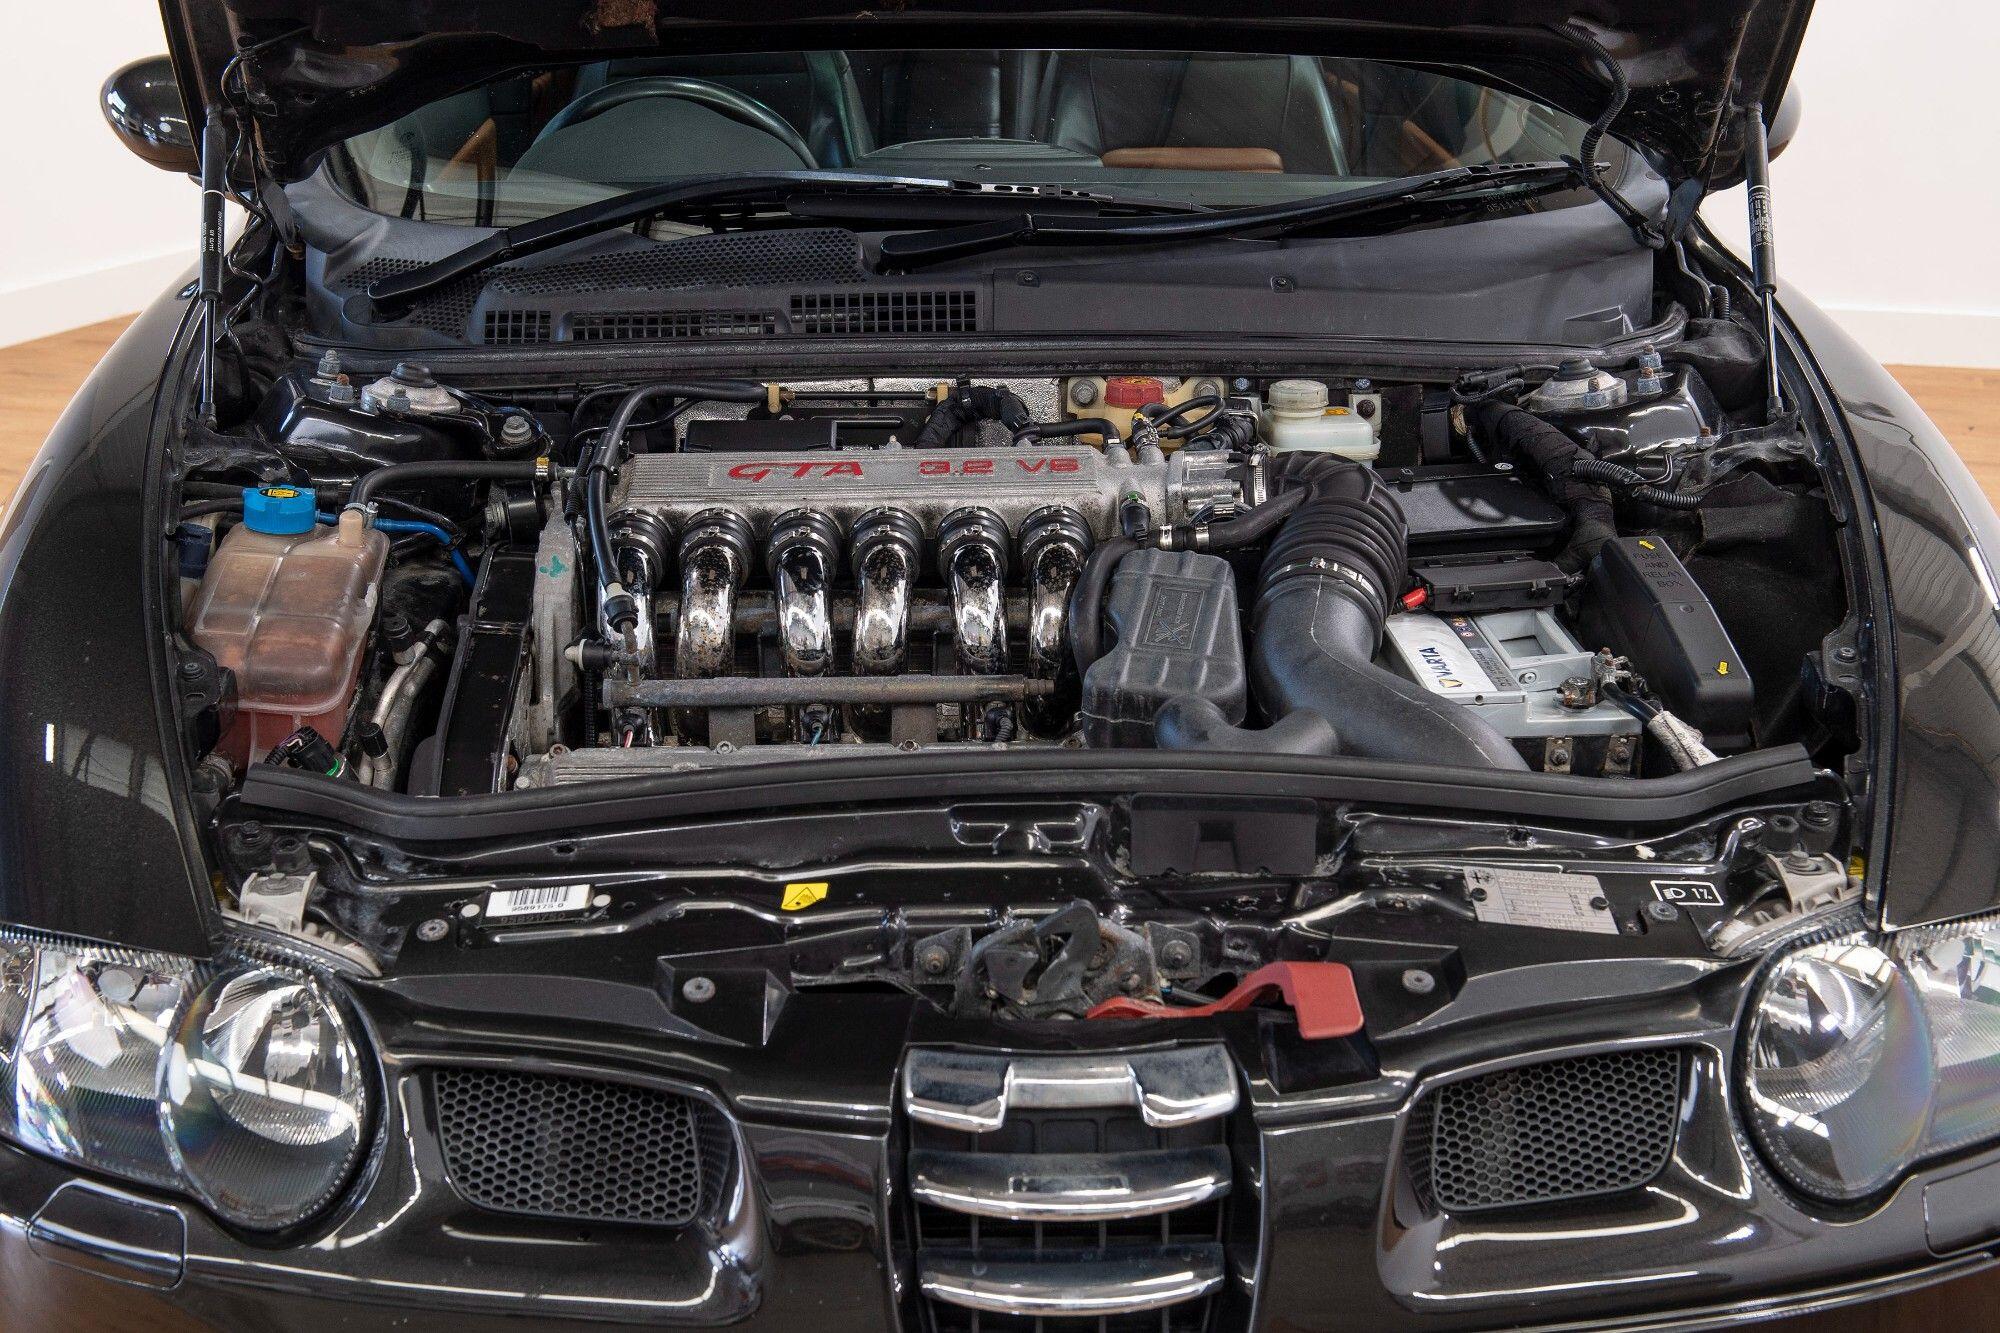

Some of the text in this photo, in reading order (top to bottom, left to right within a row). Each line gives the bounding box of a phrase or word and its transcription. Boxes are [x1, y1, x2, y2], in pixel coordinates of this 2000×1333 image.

[728, 458, 1080, 483] GTA 3.2 V6
[1632, 552, 1665, 560] FUSE
[1642, 570, 1682, 578] RELAY
[1656, 580, 1685, 588] BOX
[1419, 647, 1453, 678] VARTA
